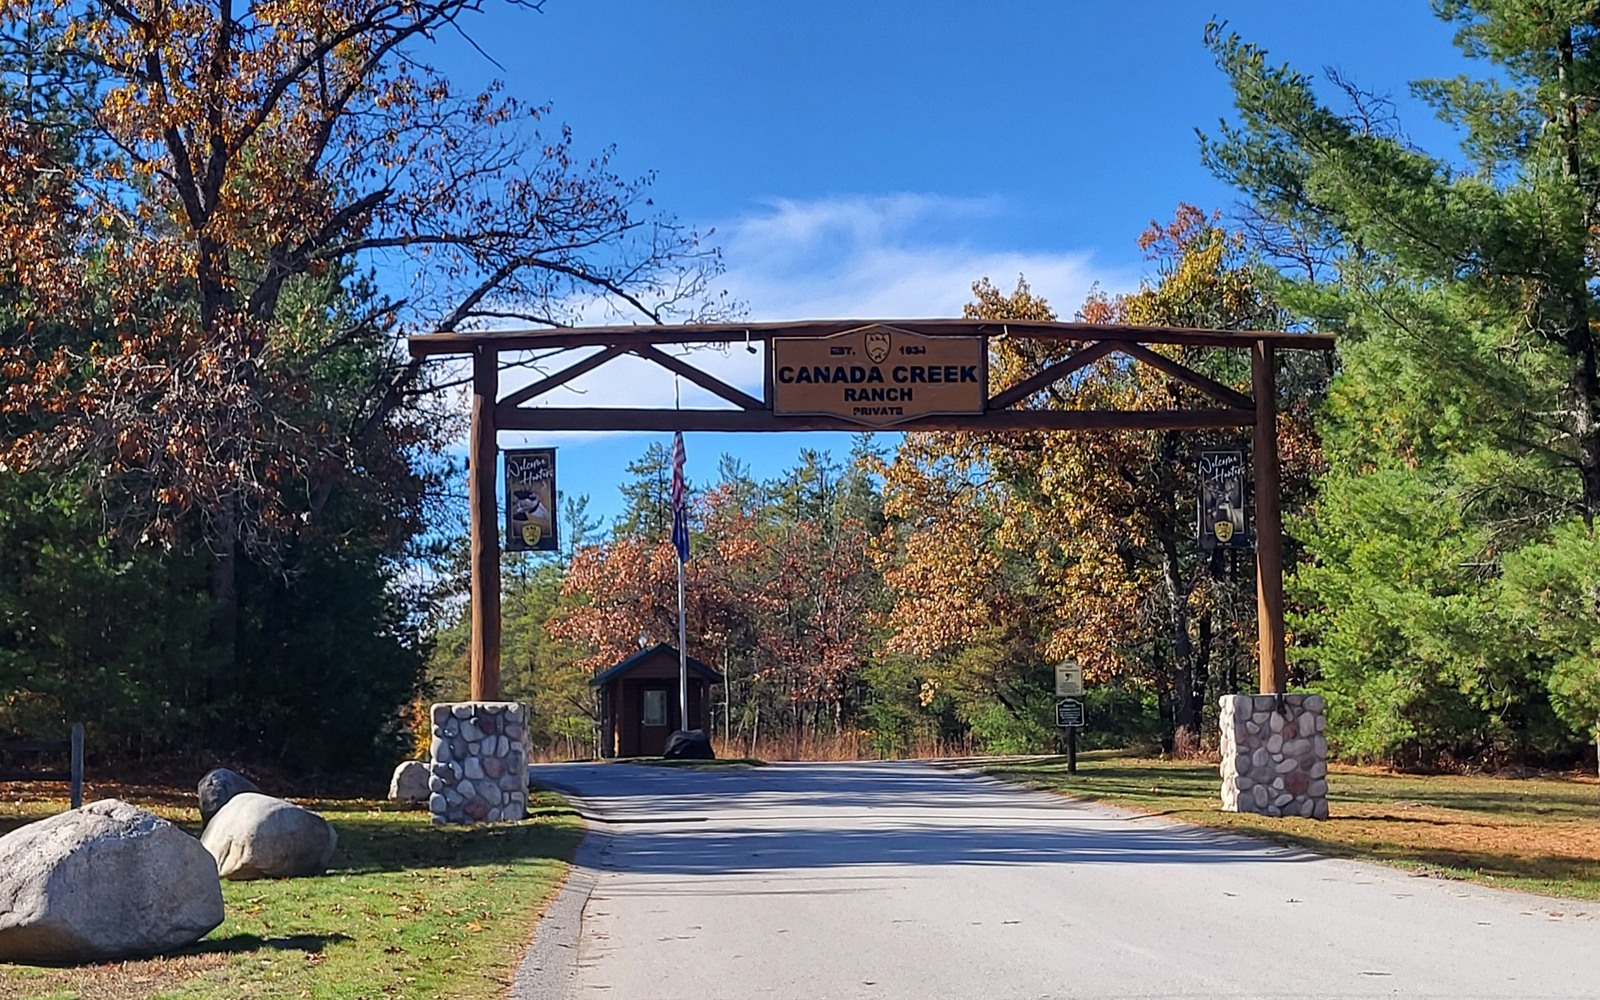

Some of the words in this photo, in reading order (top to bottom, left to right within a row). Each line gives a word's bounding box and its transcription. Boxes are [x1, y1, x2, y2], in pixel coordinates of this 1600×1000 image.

[830, 346, 856, 356] EST.
[778, 366, 884, 383] CANADA
[892, 366, 978, 383] CREEK
[844, 388, 913, 401] RANCH
[853, 407, 903, 416] PRIVATE
[507, 458, 546, 479] Welcome
[1198, 455, 1238, 475] Welcome
[519, 468, 553, 487] Hunters
[1211, 465, 1245, 483] Hunters
